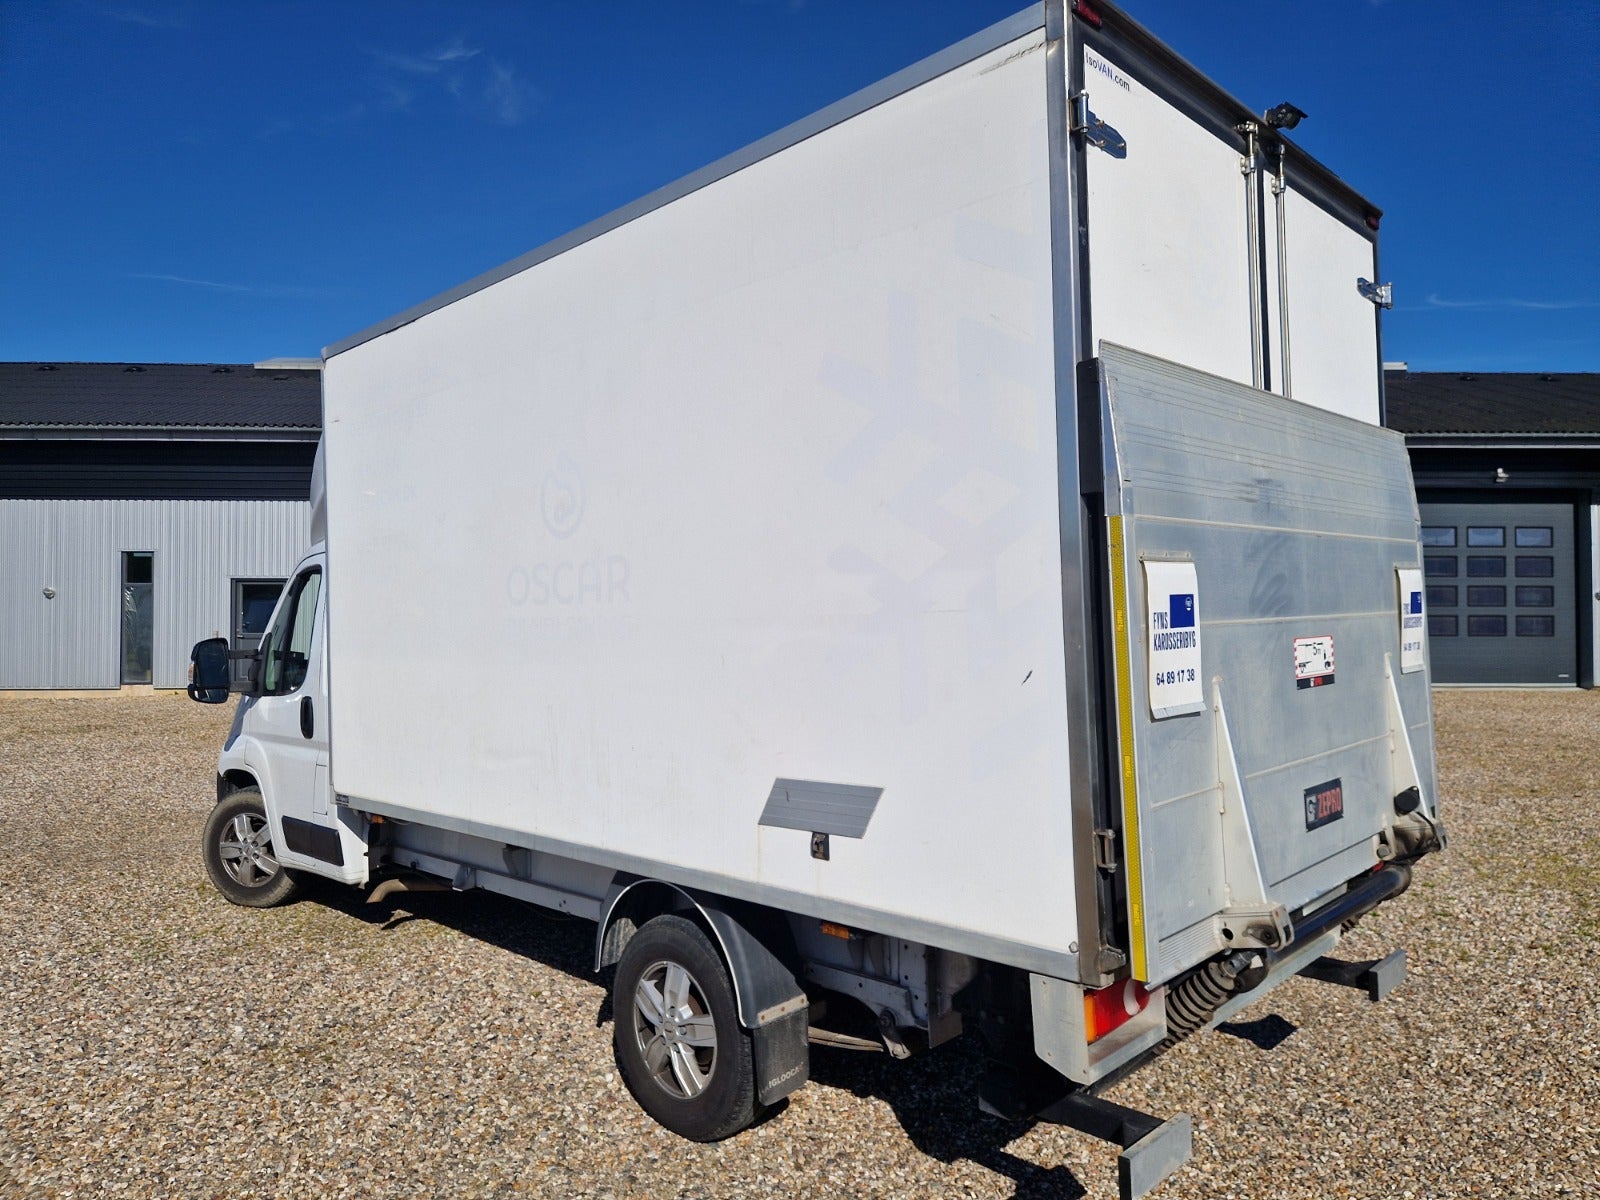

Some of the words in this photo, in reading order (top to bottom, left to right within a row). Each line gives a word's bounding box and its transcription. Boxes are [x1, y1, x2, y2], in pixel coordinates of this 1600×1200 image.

[1085, 52, 1130, 91] IsoVAN.com
[506, 554, 631, 606] OSCAR
[1153, 612, 1168, 629] FYNS
[1153, 631, 1196, 651] KAROSSERIBYG
[1156, 672, 1165, 685] 64
[1166, 671, 1175, 684] 89
[1177, 669, 1184, 683] 17
[1187, 668, 1195, 681] 38
[1317, 787, 1341, 818] ZEPRO
